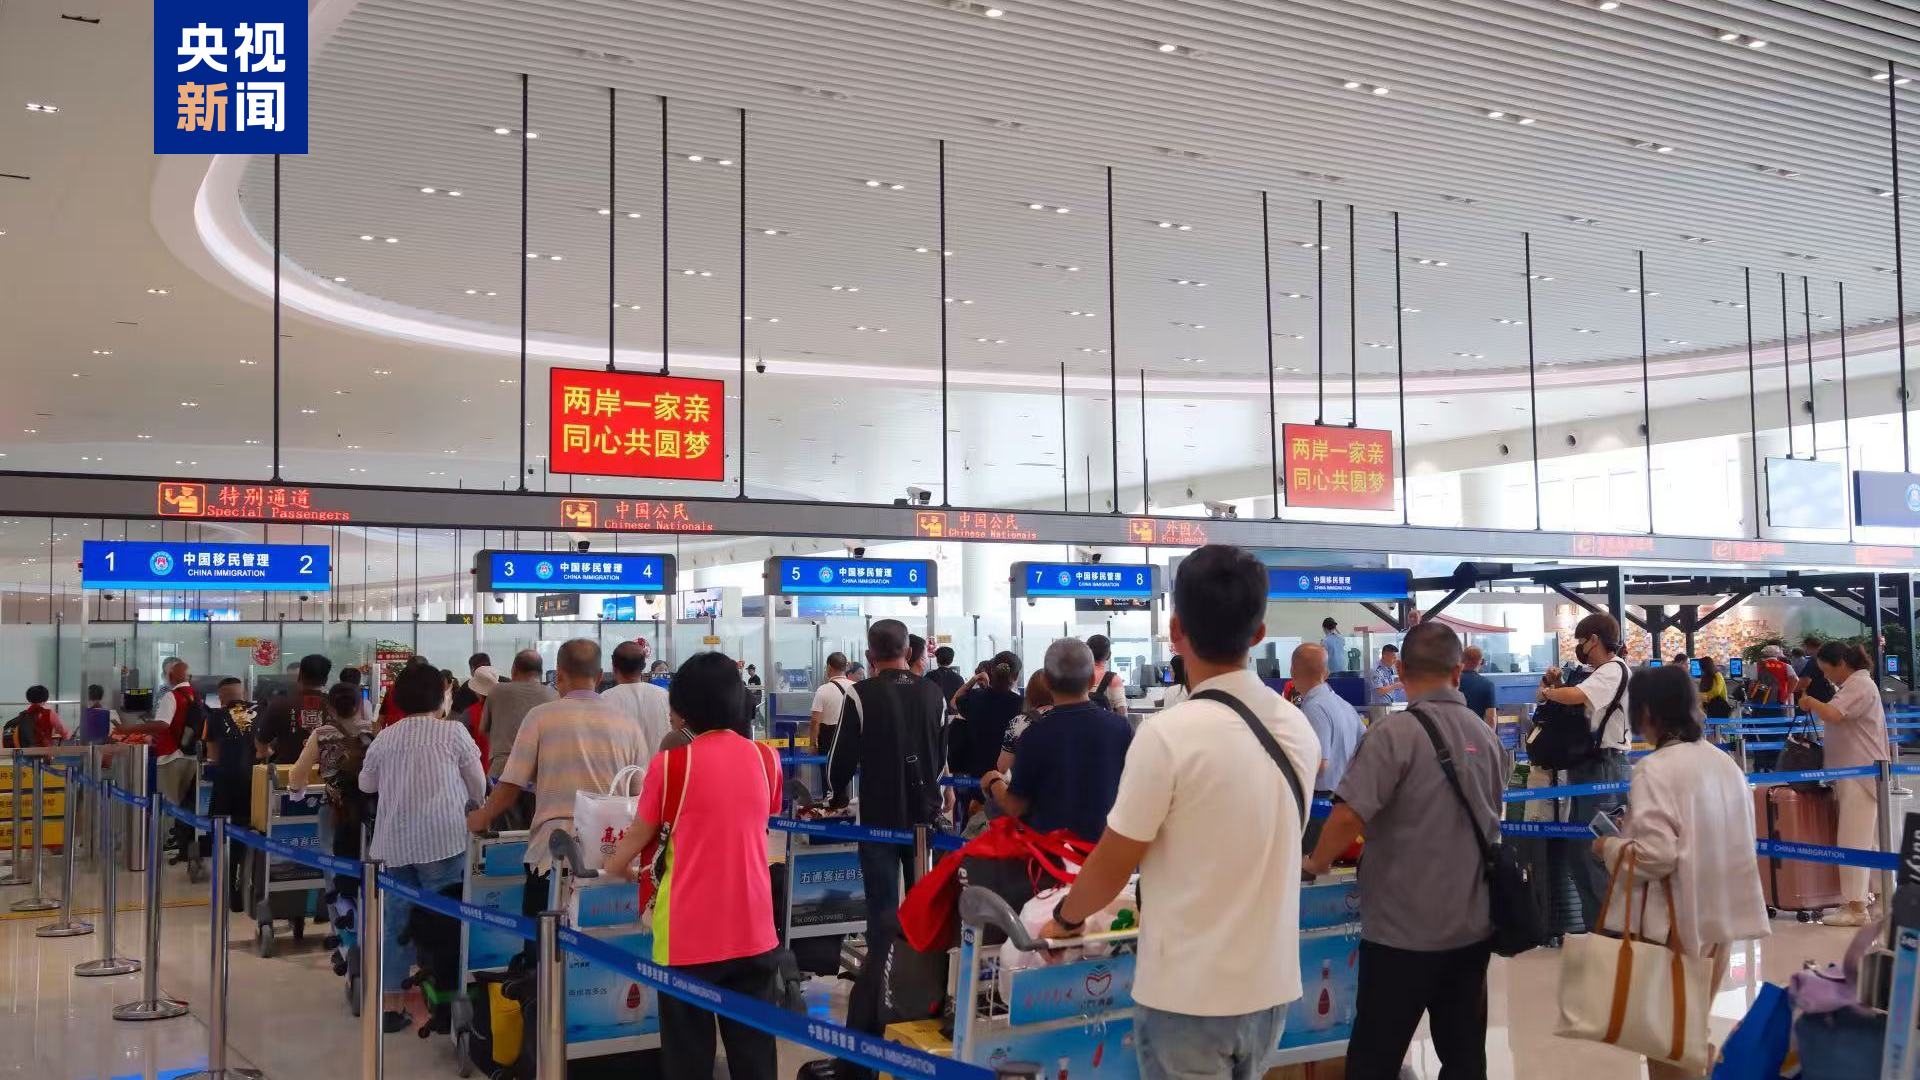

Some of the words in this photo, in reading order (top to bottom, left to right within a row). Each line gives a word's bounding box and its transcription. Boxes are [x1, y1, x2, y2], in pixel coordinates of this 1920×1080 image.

[562, 385, 711, 423] 两岸一家亲
[562, 423, 711, 460] 同心共圆梦
[1291, 437, 1384, 465] 两岸一家亲
[1293, 467, 1385, 494] 同心共圆梦
[218, 486, 312, 508] 特别通道
[207, 505, 264, 519] Special
[271, 509, 350, 521] Passengers
[615, 501, 689, 521] 中国公民
[604, 519, 651, 530] Chinese
[656, 520, 713, 531] Nationals
[958, 511, 1019, 531] 中国公民
[949, 528, 986, 538] Chinese
[990, 529, 1037, 540] Nationals
[104, 551, 115, 572] 1
[183, 552, 270, 567] 中国移民管理
[299, 555, 313, 574] 2
[559, 561, 623, 573] 中国移民管理
[213, 569, 266, 577] IMMIGRATION
[504, 561, 514, 577] 3
[642, 564, 652, 578] 4
[791, 567, 800, 581] 5
[838, 567, 893, 578] 中国移民管理
[909, 569, 917, 582] 6
[1075, 571, 1122, 582] 中国移民管理
[1035, 571, 1043, 584] 7
[1136, 573, 1144, 586] 8
[1313, 575, 1351, 585] 中国移民管理
[1773, 844, 1796, 853] CHINA
[1796, 847, 1846, 859] IMMIGRATION
[807, 1022, 855, 1052] 中国移民管理
[860, 1039, 883, 1059] CHINA
[884, 1046, 937, 1076] IMMIGRATION
